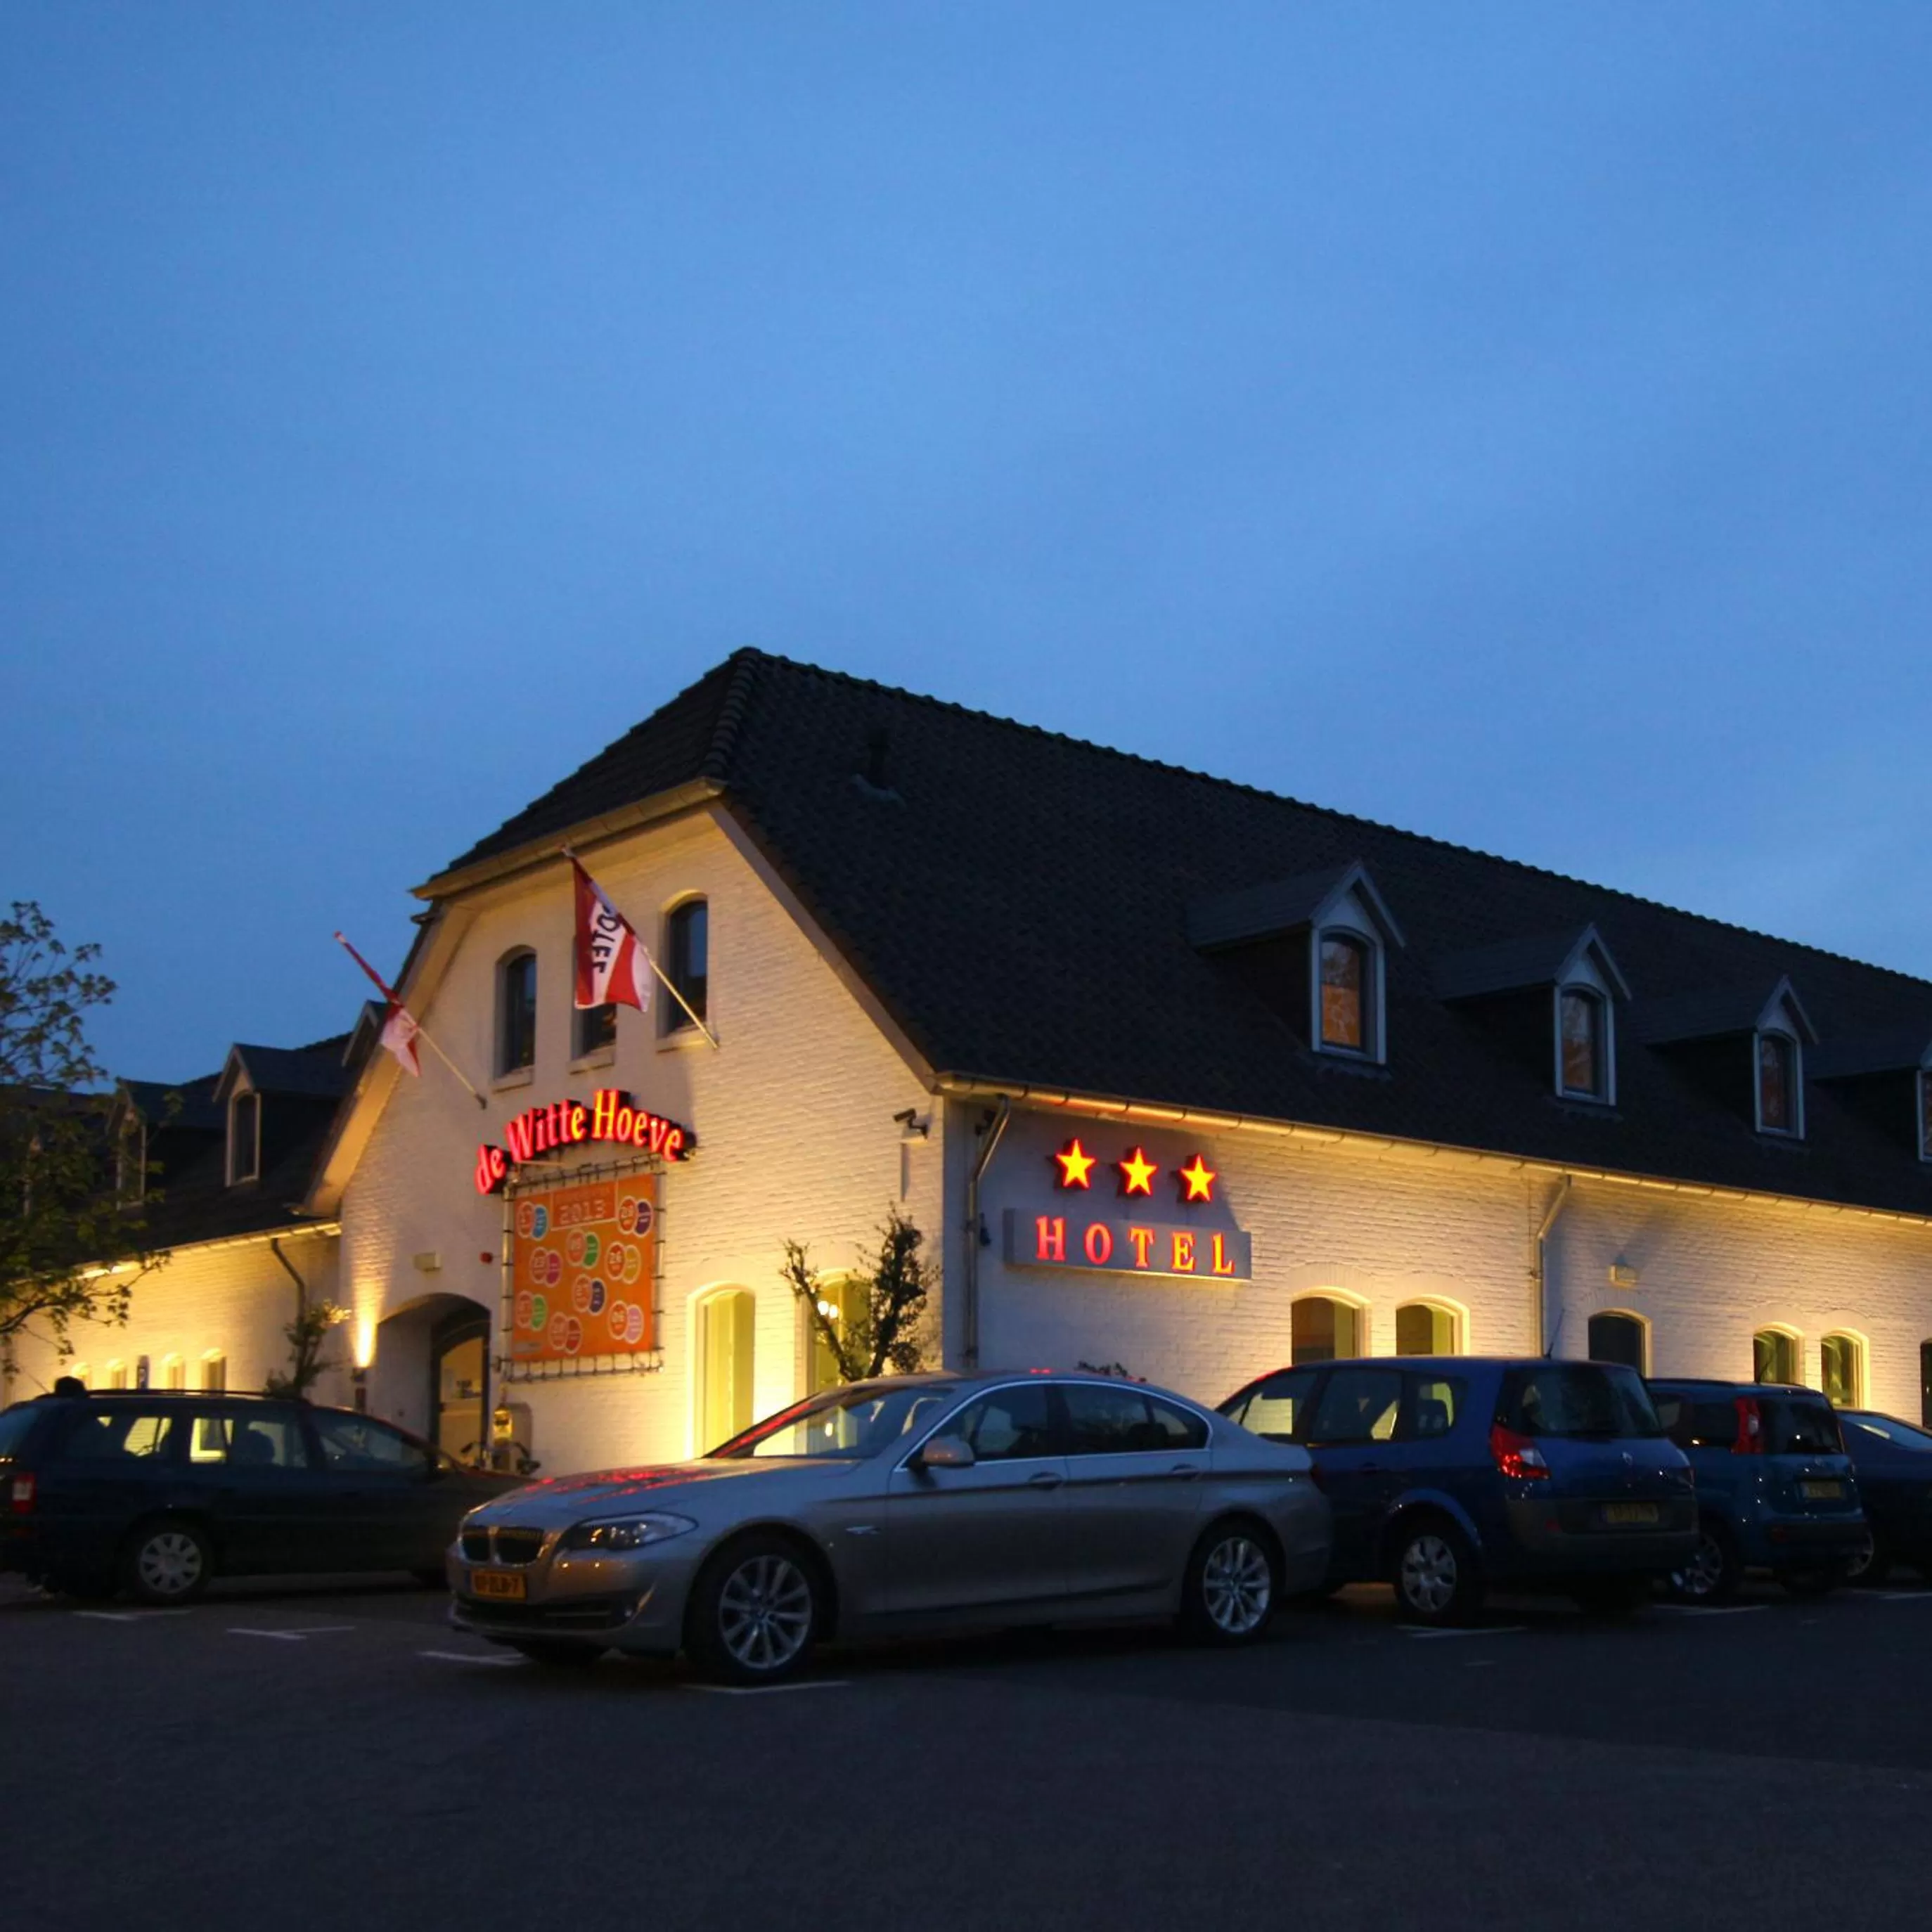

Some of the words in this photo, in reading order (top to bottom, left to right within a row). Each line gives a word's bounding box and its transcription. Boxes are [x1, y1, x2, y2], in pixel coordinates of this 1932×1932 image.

[474, 1144, 507, 1195] de
[505, 1099, 588, 1162] Witte
[592, 1089, 684, 1161] Hoeve
[1035, 1215, 1235, 1275] HOTEL
